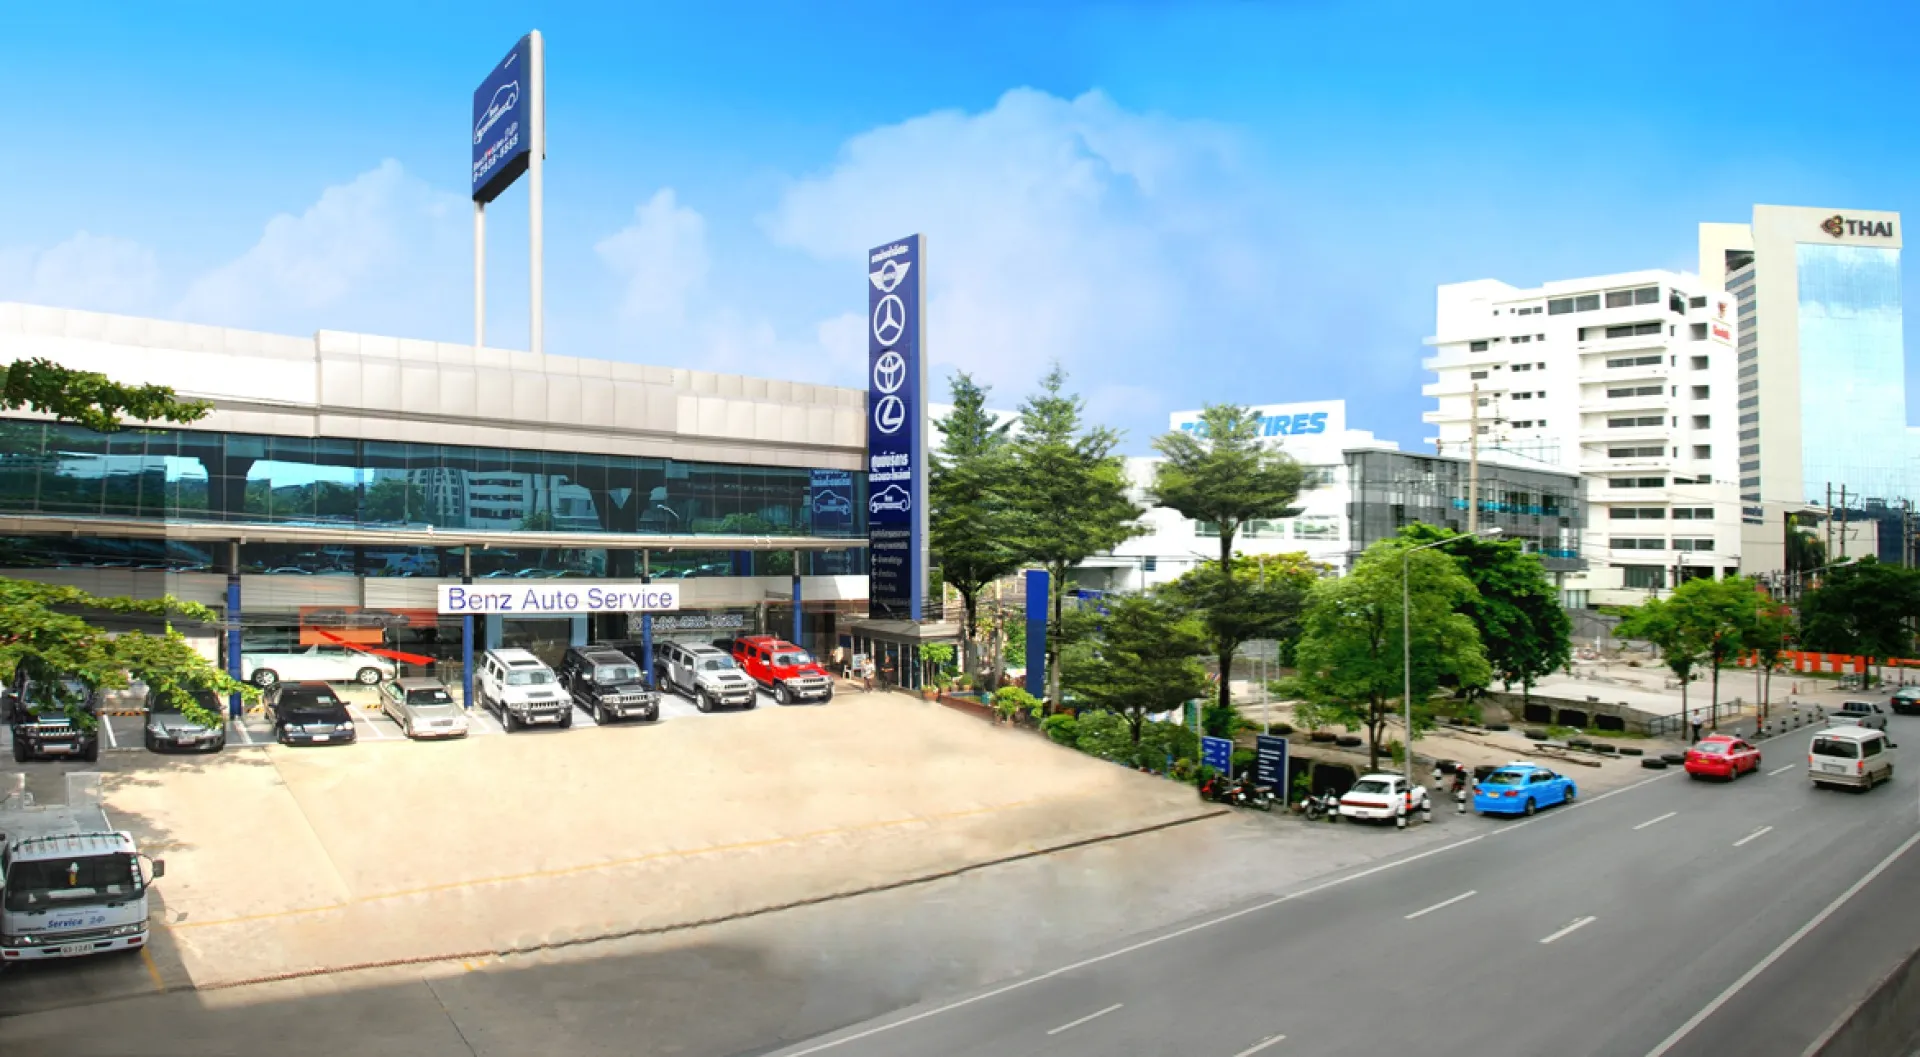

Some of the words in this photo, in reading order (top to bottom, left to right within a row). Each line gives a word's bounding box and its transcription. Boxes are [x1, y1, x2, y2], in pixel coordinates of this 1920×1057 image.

[1845, 219, 1893, 237] THAI
[1256, 412, 1328, 437] TIRES
[448, 587, 512, 611] Benz
[522, 588, 579, 611] Auto
[587, 587, 674, 610] Service
[48, 919, 83, 929] Service
